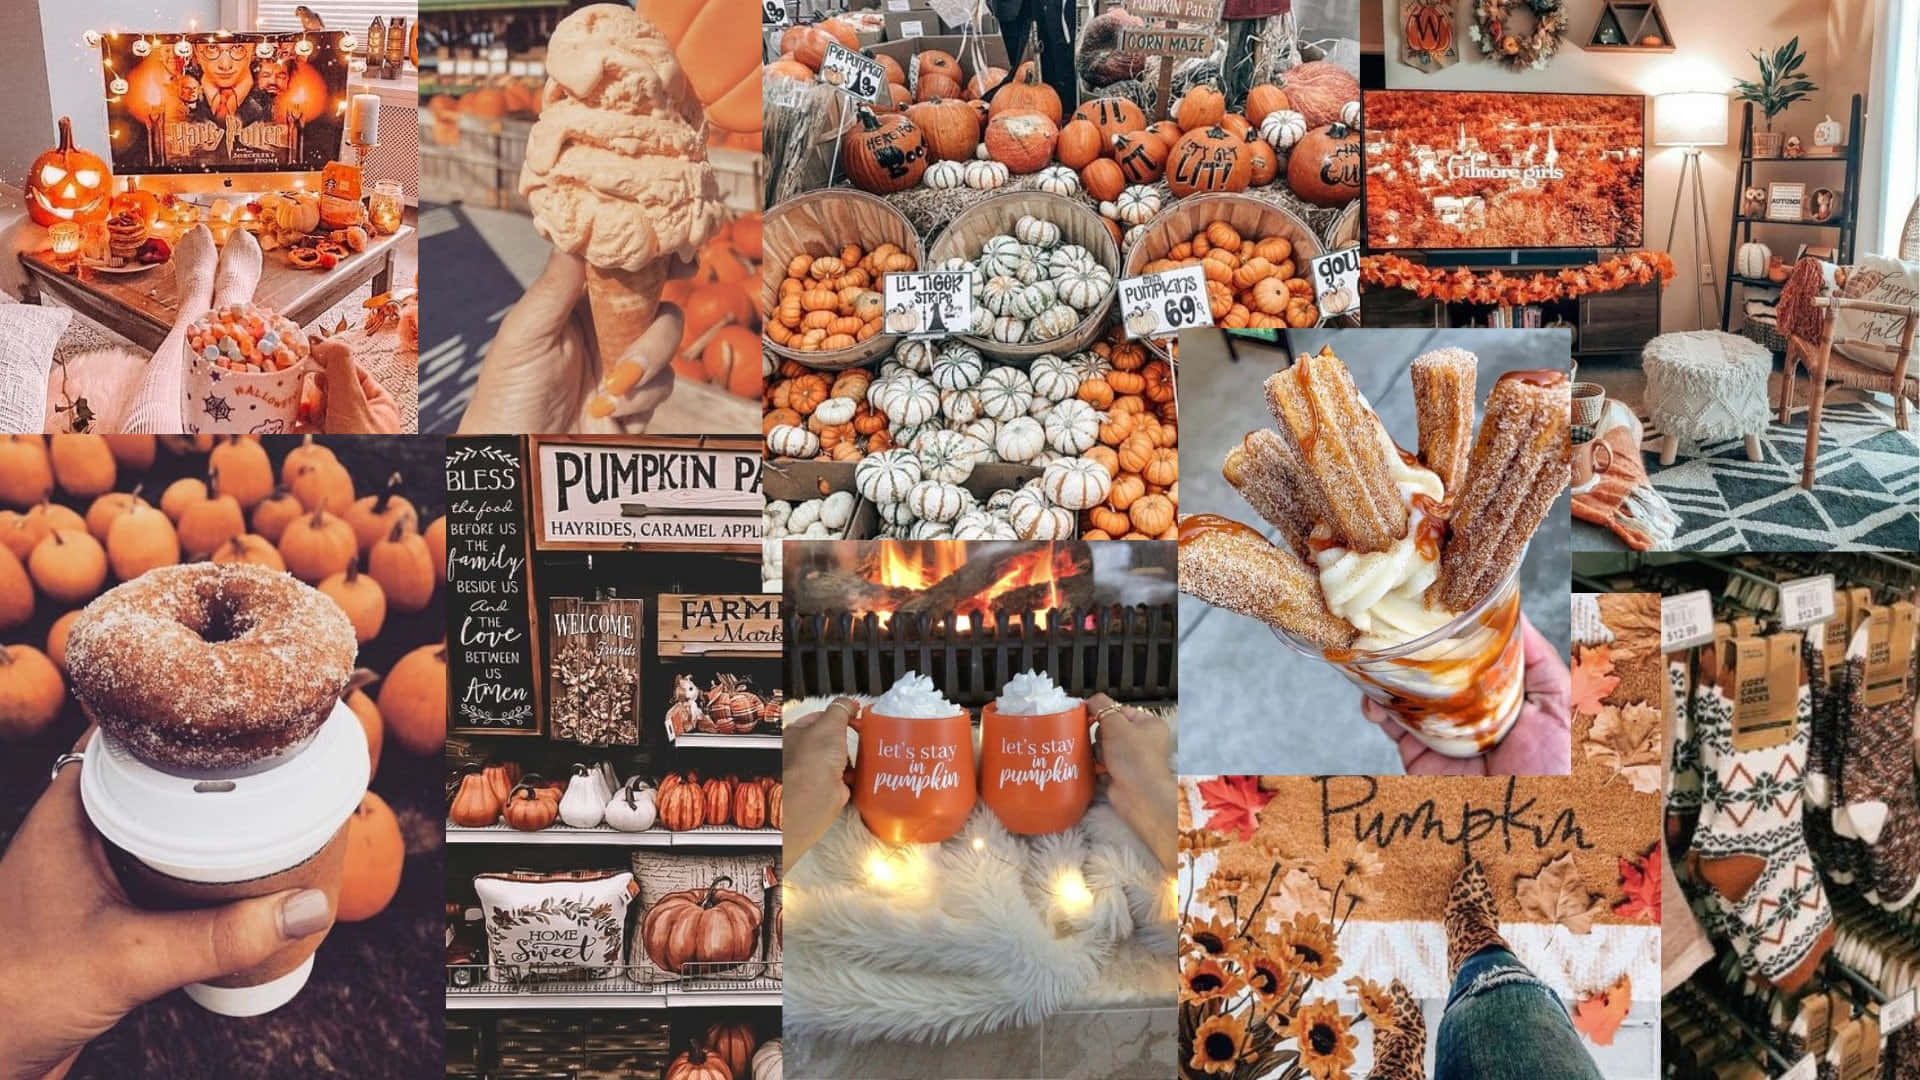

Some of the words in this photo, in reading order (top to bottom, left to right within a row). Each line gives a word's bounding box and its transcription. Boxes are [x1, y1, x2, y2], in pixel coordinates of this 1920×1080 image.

[1411, 15, 1443, 41] W
[1128, 34, 1164, 50] CORN
[1169, 37, 1205, 52] MAZE
[1447, 154, 1521, 179] Gilmore
[1522, 163, 1564, 188] girls
[1318, 248, 1360, 286] gou
[446, 468, 515, 491] BLESS
[555, 452, 717, 512] PUMPKIN
[451, 499, 476, 513] the
[475, 499, 513, 521] food
[451, 523, 494, 535] BEFORE
[500, 523, 517, 535] US
[551, 521, 636, 538] HAYRIDES,
[640, 522, 716, 537] CARAMEL
[721, 524, 763, 538] APPL
[465, 540, 488, 552] THE
[448, 544, 525, 582] family
[457, 580, 497, 593] BESIDE
[502, 580, 519, 594] US
[477, 617, 503, 628] THE
[554, 613, 634, 639] WELCOME
[465, 651, 520, 664] BETWEEN
[595, 641, 637, 657] Friends
[485, 668, 502, 680] US
[462, 677, 528, 703] Amen
[878, 739, 915, 759] let's
[920, 744, 957, 762] stay
[1001, 737, 1037, 755] let's
[1041, 738, 1075, 755] stay
[909, 759, 925, 774] in
[1032, 755, 1047, 769] in
[873, 761, 959, 799] pumpkin
[999, 755, 1079, 792] pumpkin
[1310, 775, 1594, 864] Pumpkin
[529, 930, 578, 941] HOME
[512, 935, 596, 963] Sweet
